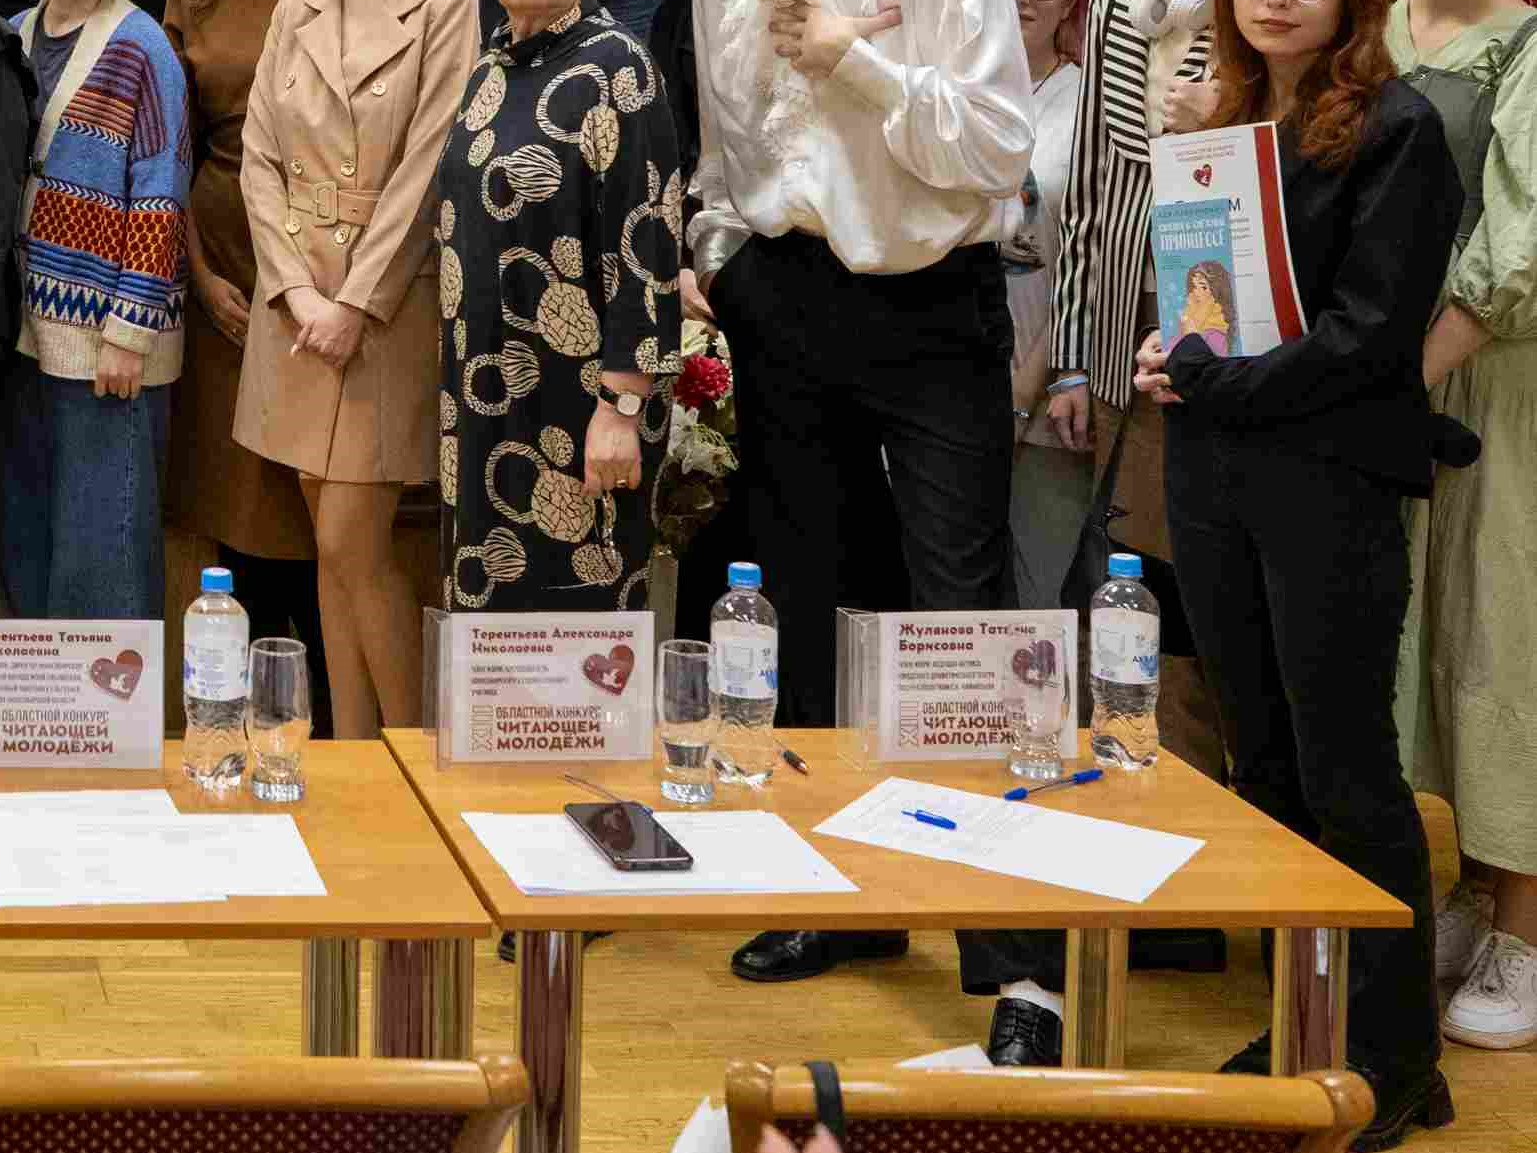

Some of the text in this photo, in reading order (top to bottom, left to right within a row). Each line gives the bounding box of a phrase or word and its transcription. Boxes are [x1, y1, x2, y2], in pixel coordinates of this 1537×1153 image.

[58, 631, 113, 643] Татьяна
[471, 627, 634, 642] Терентьева Александра
[471, 642, 554, 654] Николаевна
[899, 639, 974, 654] Борисовна
[923, 699, 980, 713] ОБЛАСТНОЙ
[1, 709, 110, 723] ОБЛАСТНОЙ КОНКУРС
[2, 723, 108, 738] ЧИТАЮЩЕЙ
[496, 721, 601, 734] ЧИТАЮЩЕЙ
[924, 729, 1017, 747] МОЛОДЁЖ
